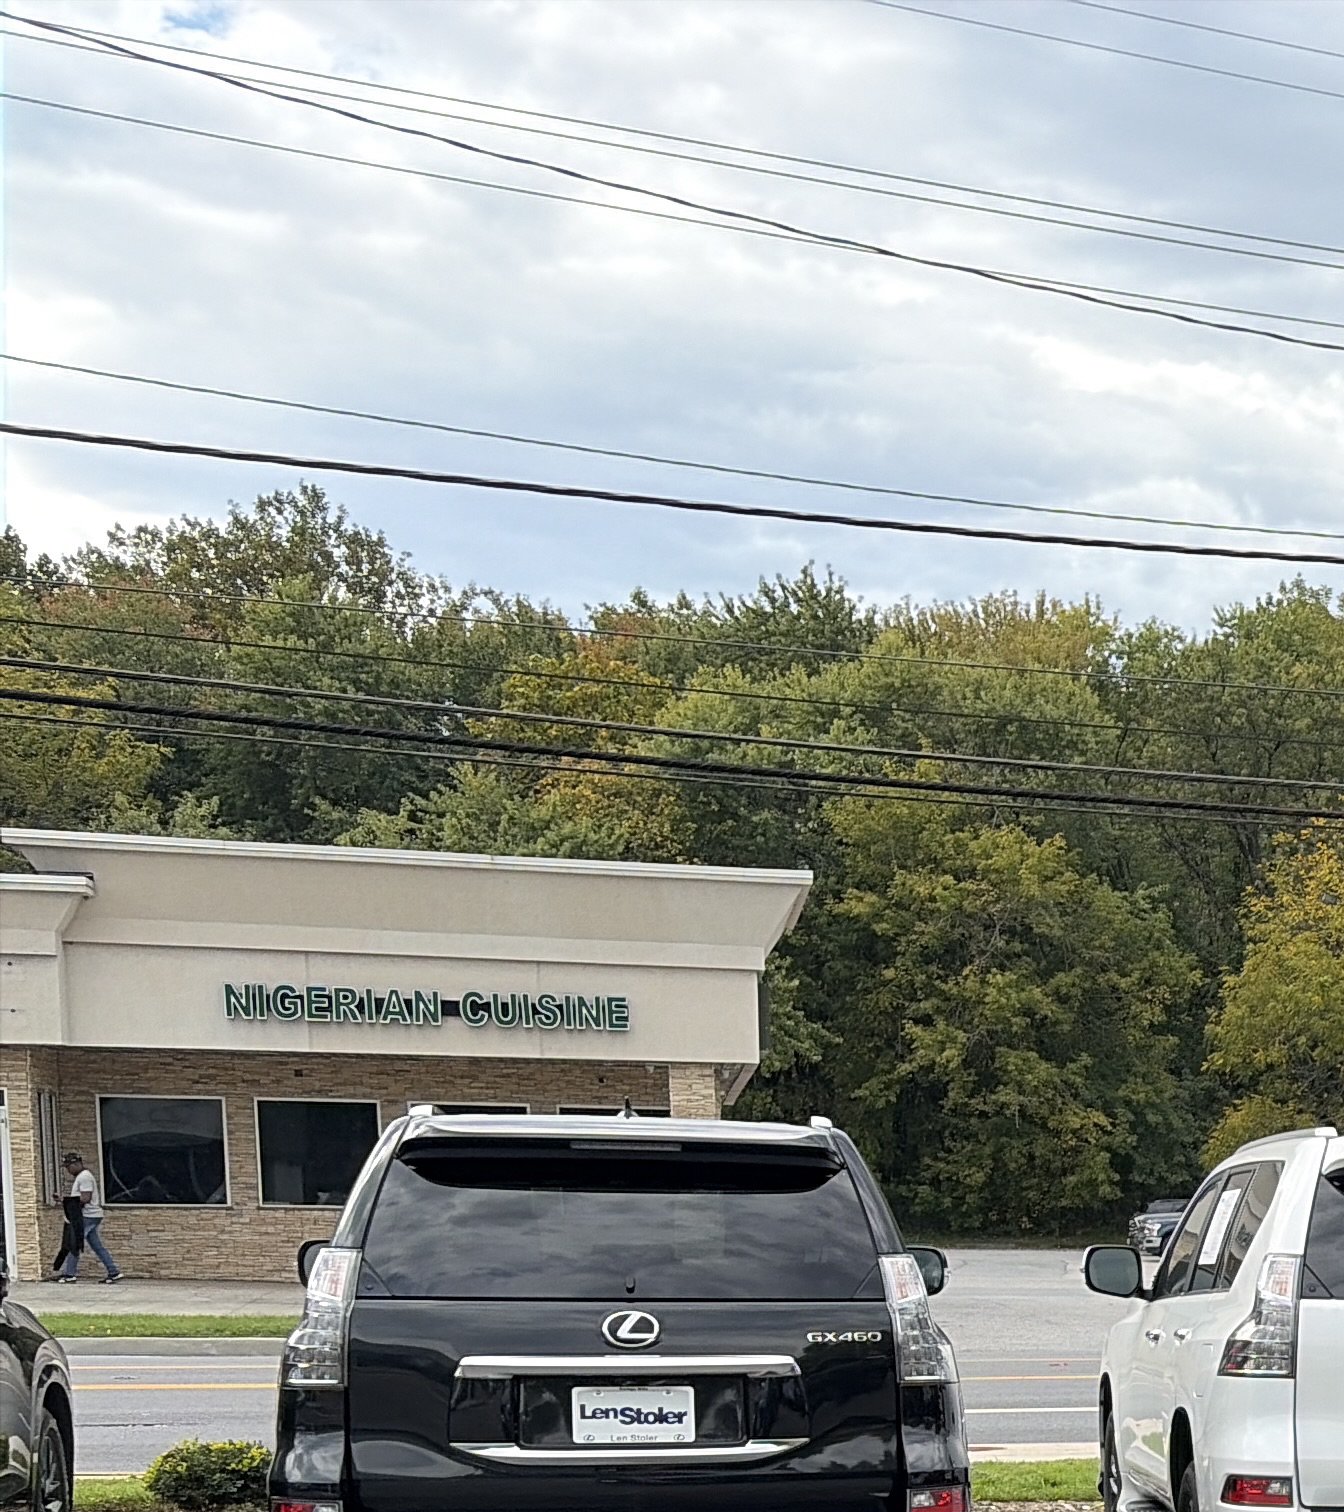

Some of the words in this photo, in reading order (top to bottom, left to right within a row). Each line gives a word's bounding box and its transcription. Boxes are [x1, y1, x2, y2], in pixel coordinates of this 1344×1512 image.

[222, 981, 442, 1026] NIGERIAN
[458, 990, 630, 1031] CUISINE
[806, 1330, 883, 1343] GX460
[610, 1433, 628, 1442] Len
[630, 1433, 659, 1442] Stoler
